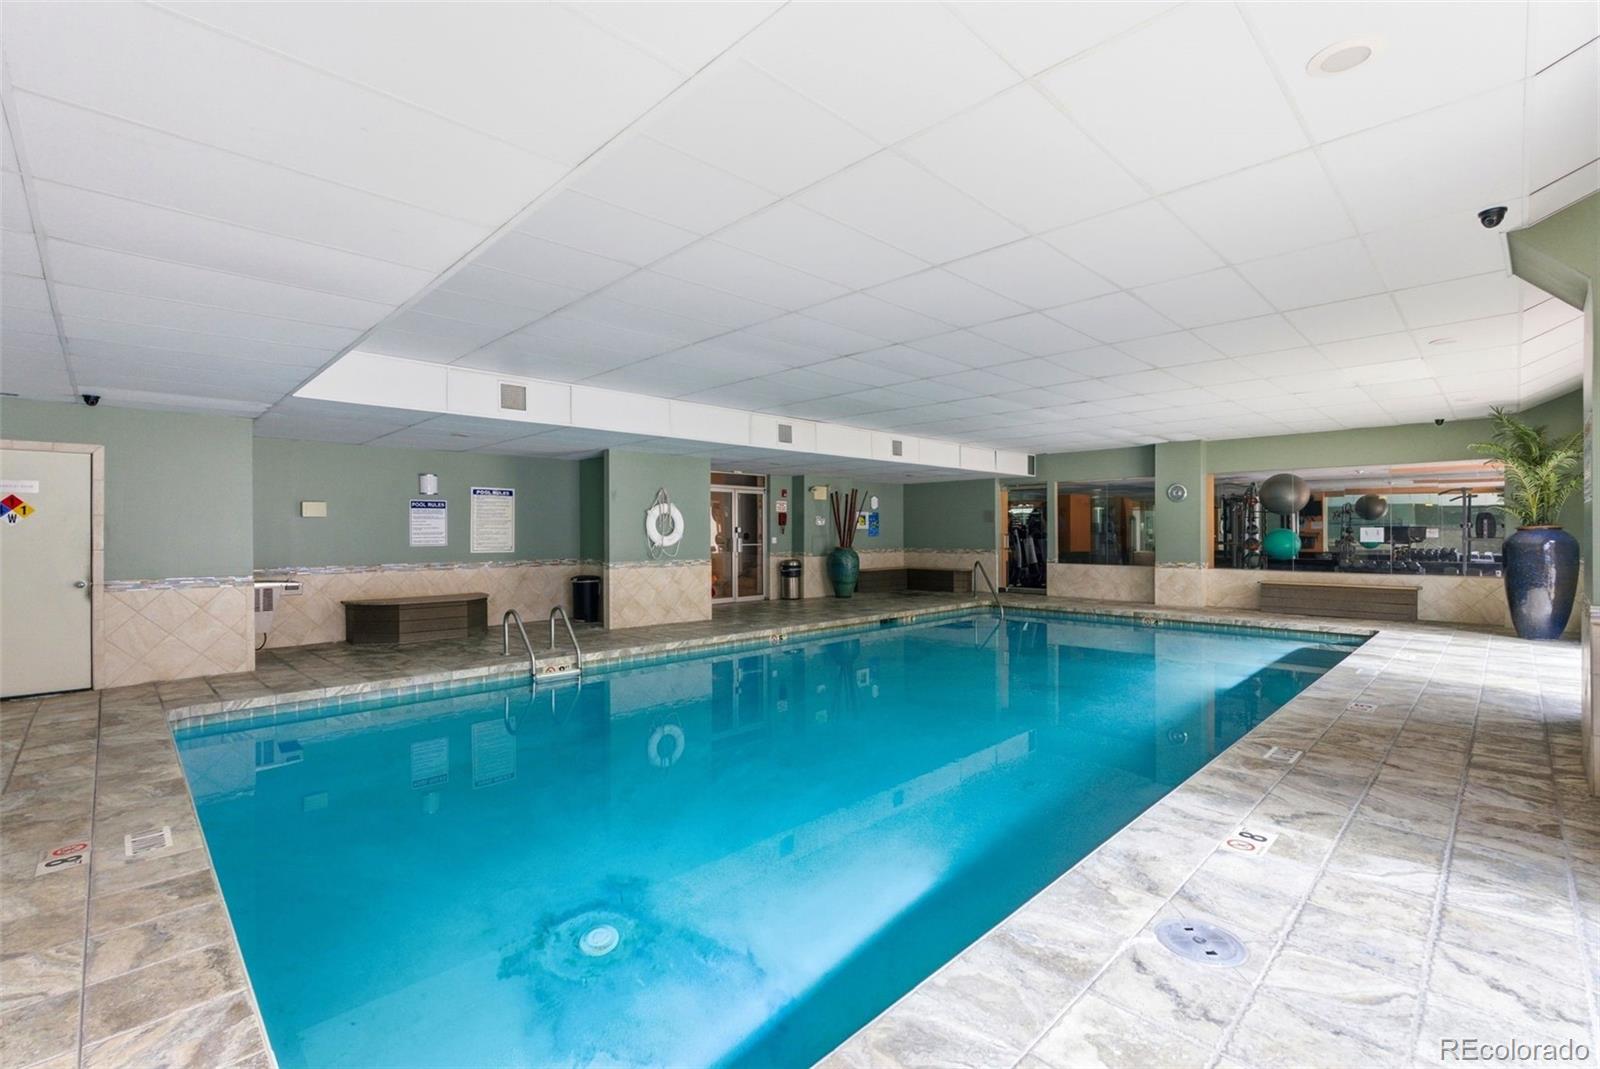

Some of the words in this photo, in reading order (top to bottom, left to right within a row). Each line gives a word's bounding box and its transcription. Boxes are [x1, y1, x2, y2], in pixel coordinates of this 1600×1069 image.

[20, 505, 26, 515] 1
[7, 513, 17, 523] W
[1238, 831, 1268, 842] 8
[44, 855, 83, 867] 8
